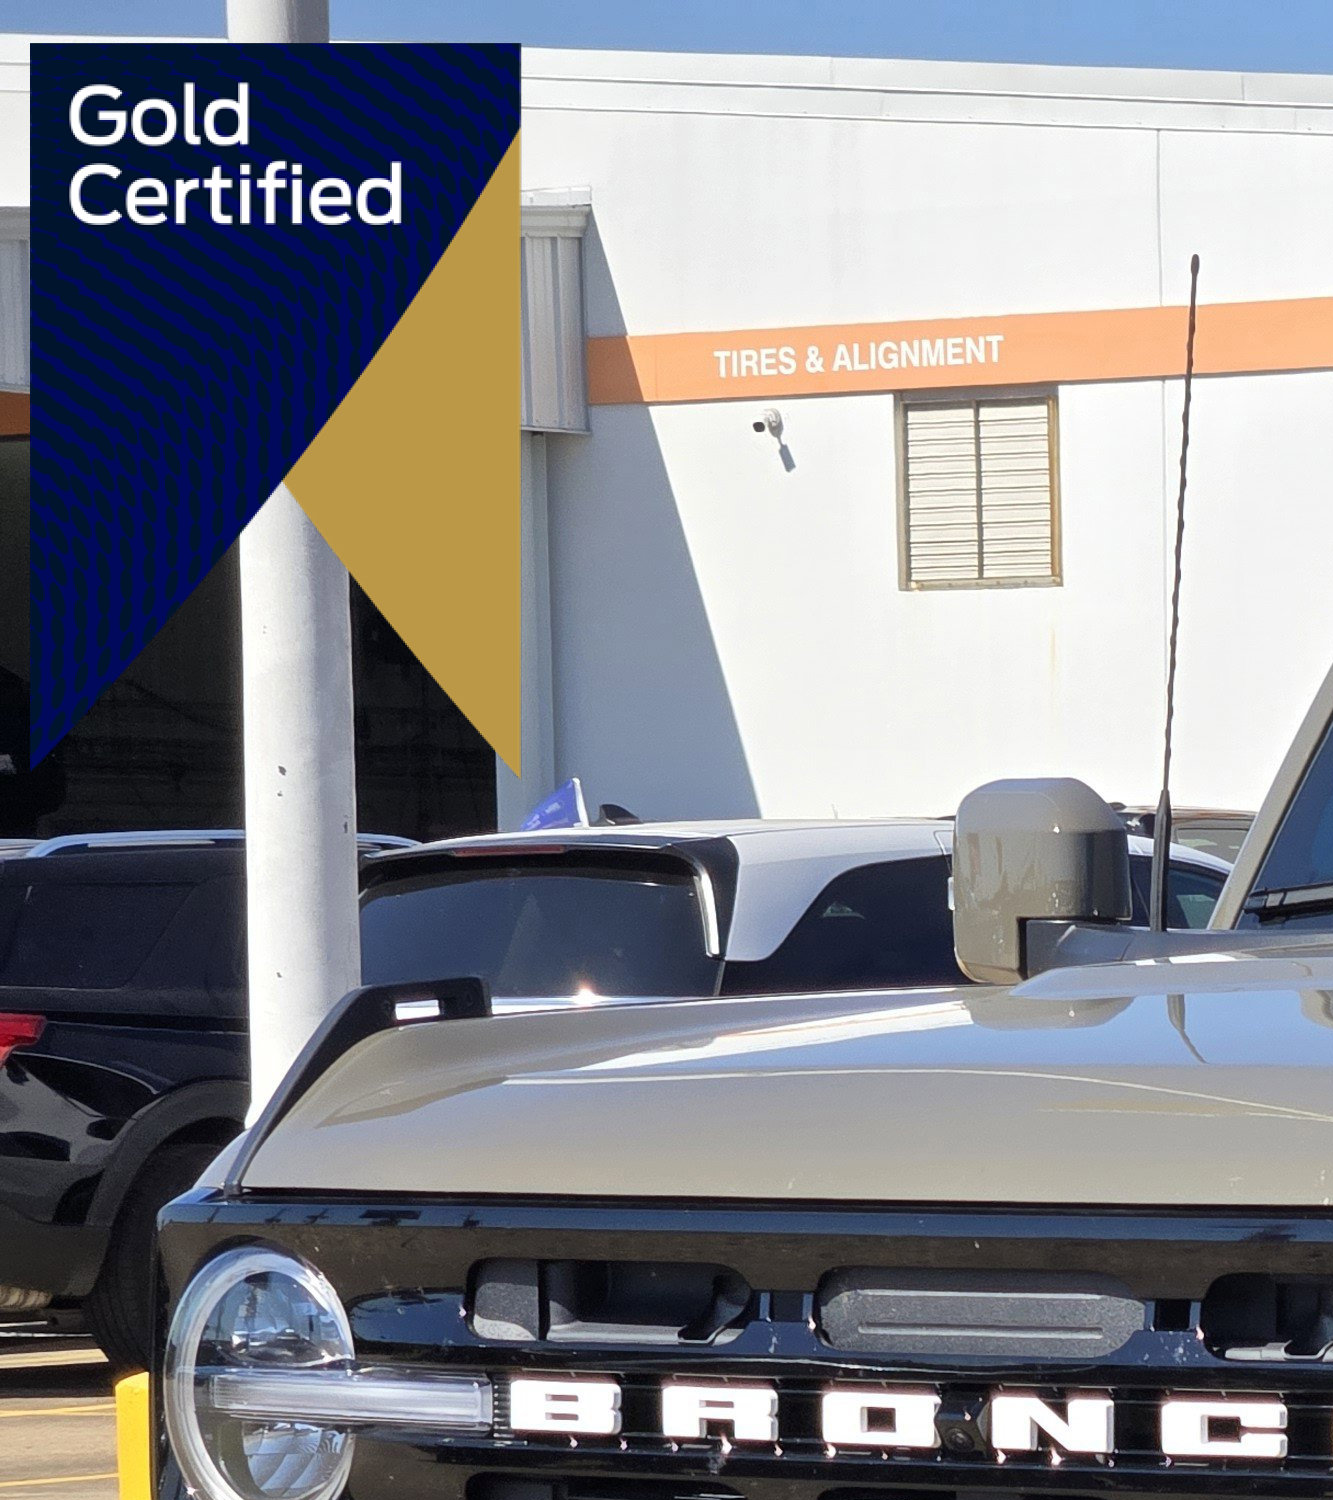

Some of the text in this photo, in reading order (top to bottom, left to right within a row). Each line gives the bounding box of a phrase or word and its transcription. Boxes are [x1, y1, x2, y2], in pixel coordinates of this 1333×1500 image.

[713, 334, 1005, 379] TIRES & ALIGNMENT
